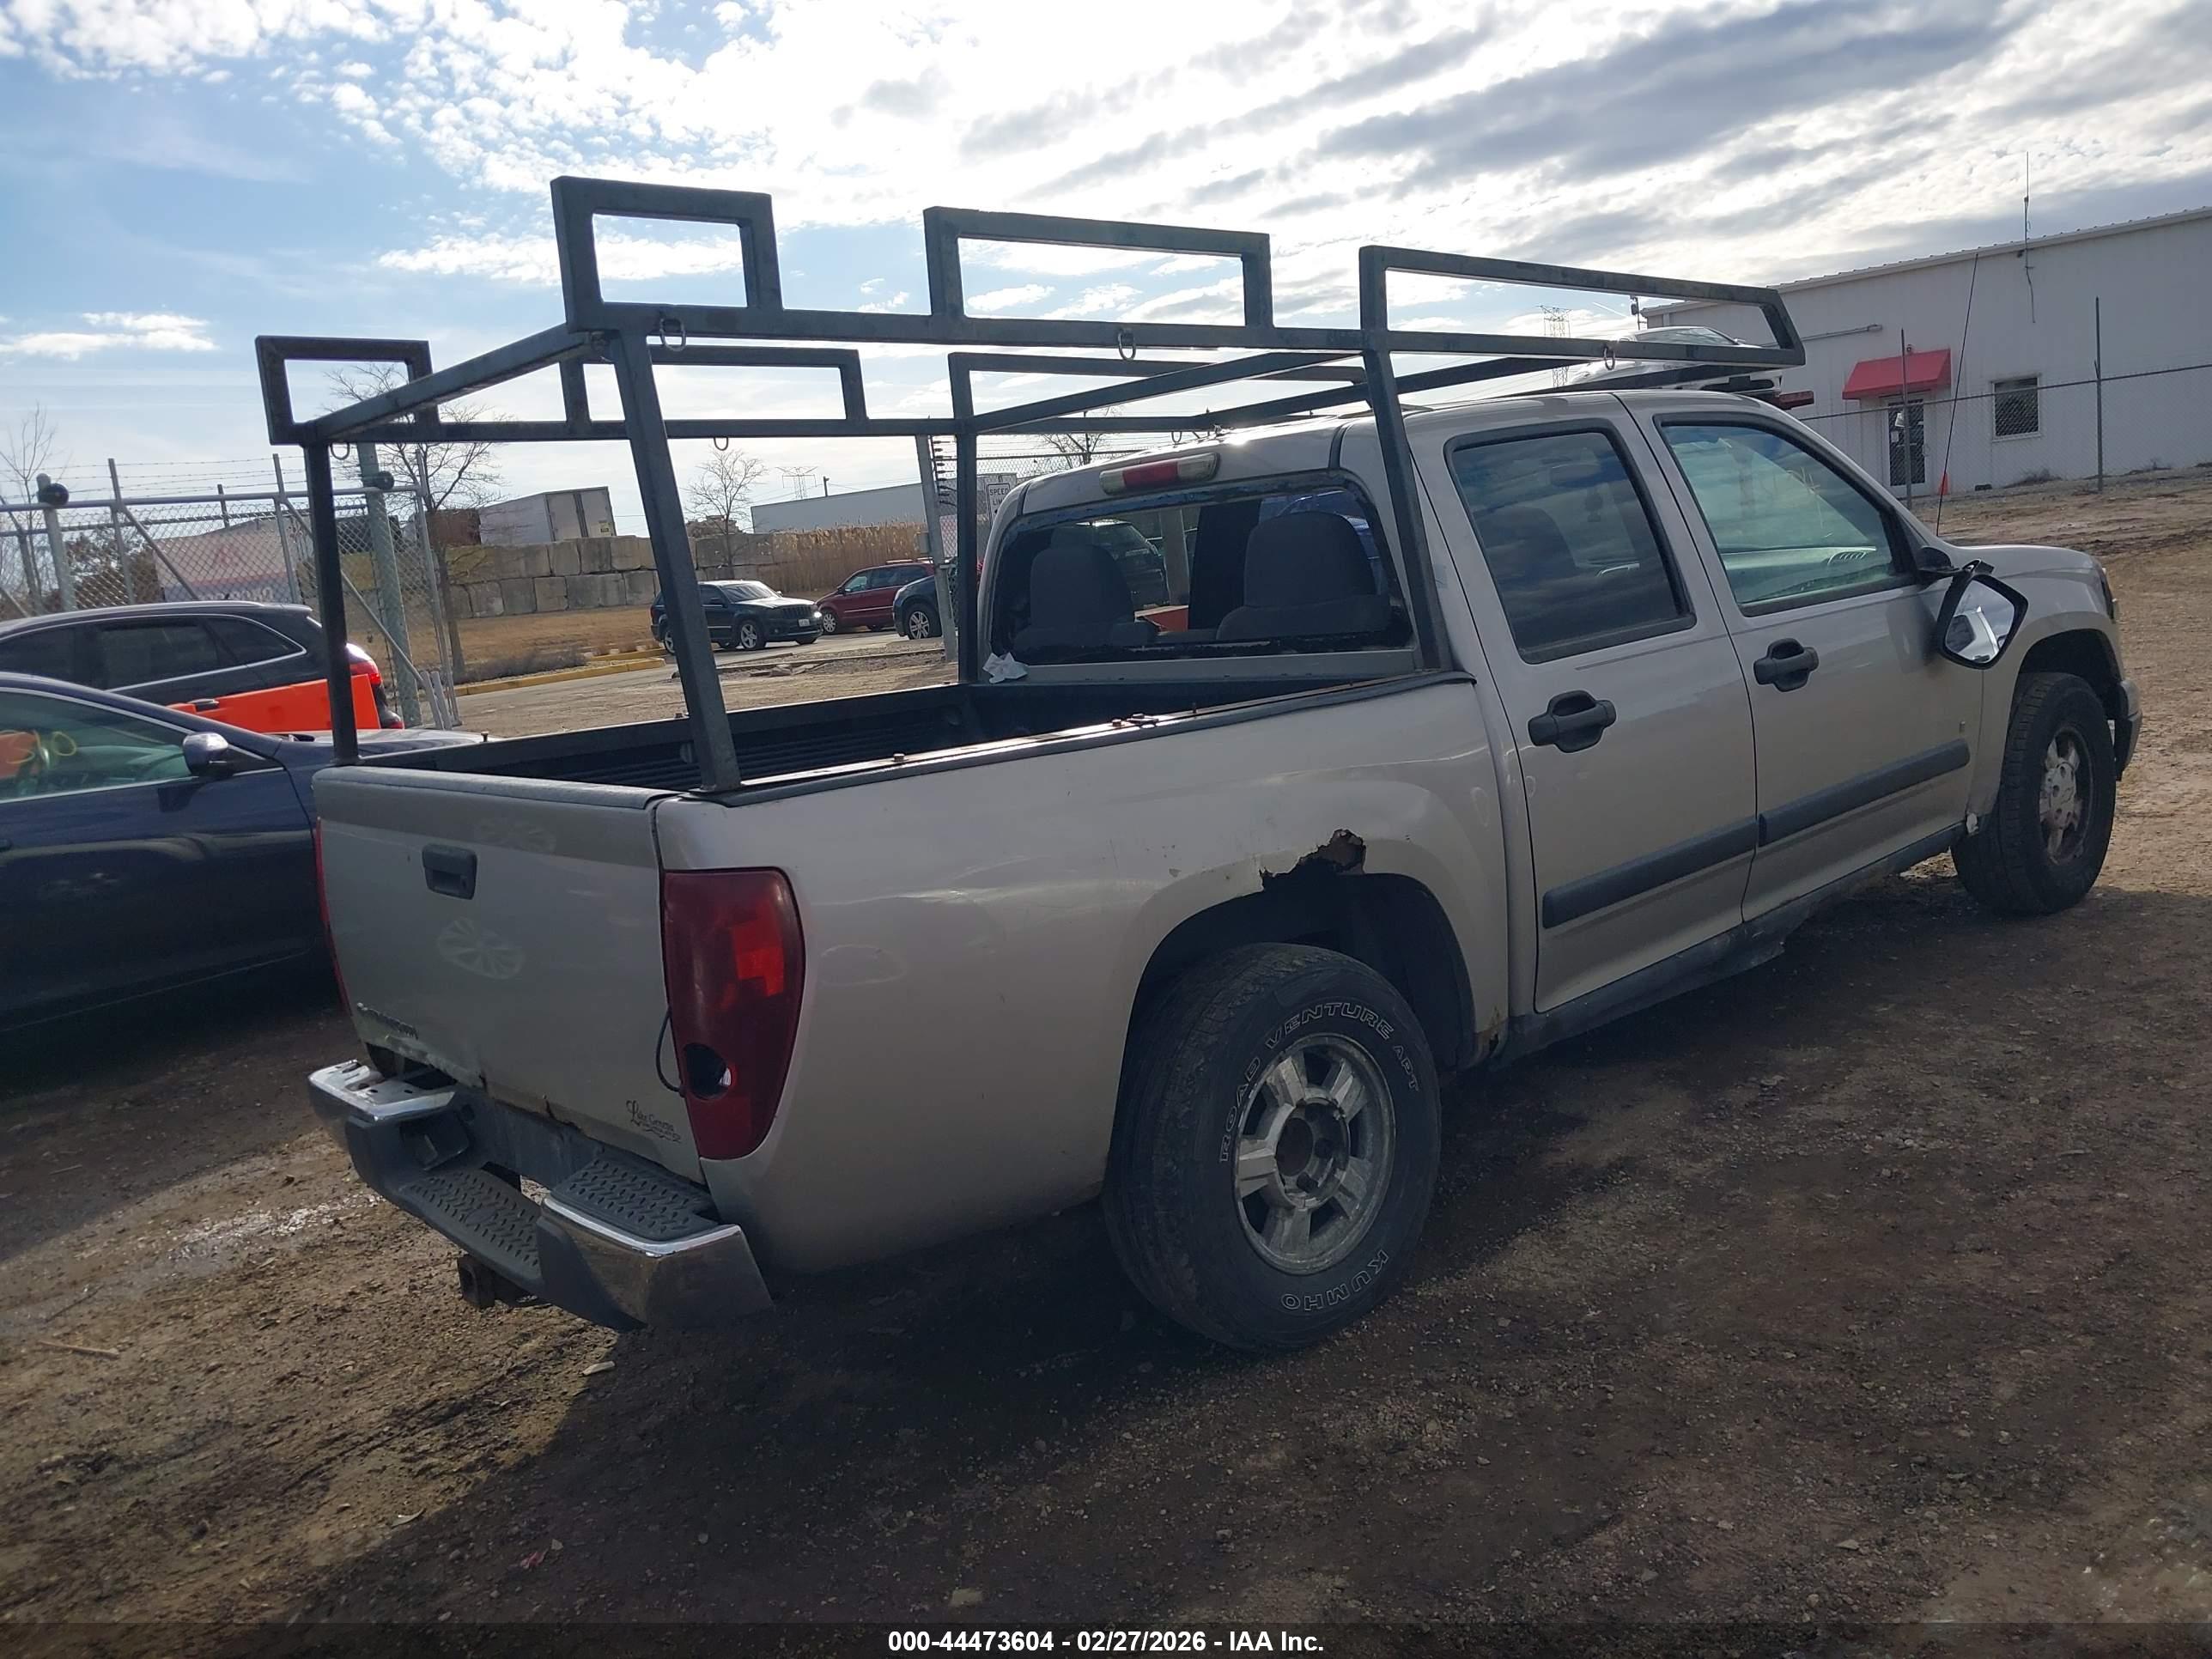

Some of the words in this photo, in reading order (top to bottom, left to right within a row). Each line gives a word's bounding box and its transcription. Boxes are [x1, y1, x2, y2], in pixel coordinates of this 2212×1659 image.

[989, 488, 1008, 496] SPEED
[1219, 1056, 1261, 1162] ROAD
[1266, 1002, 1395, 1050] VENTURE
[1394, 1044, 1420, 1091] APT
[1280, 1249, 1389, 1311] KUMHO
